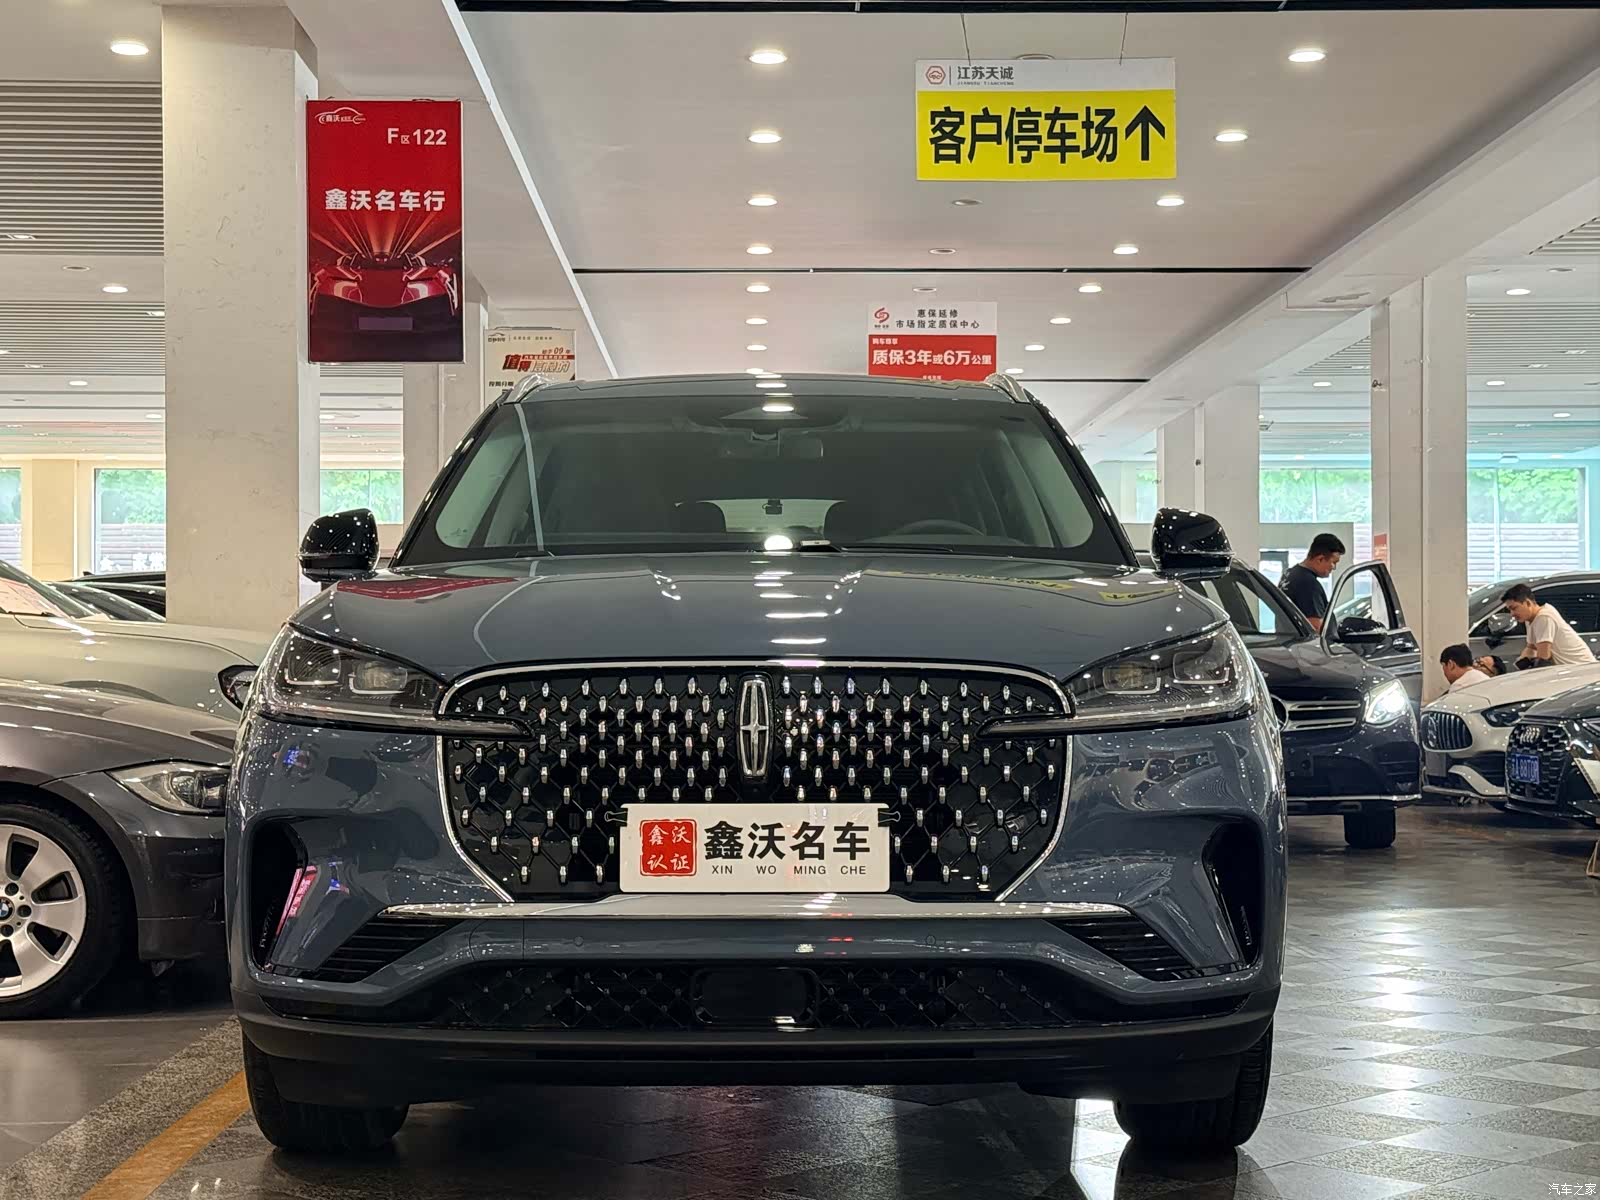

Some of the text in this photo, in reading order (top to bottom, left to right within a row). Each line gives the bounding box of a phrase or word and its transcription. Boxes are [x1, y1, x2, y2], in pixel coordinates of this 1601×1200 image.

[957, 66, 1014, 81] 江苏天诚
[929, 106, 1118, 164] 客户停车场
[325, 188, 446, 212] 鑫沃名车行
[917, 309, 958, 318] 惠保延修
[896, 319, 980, 329] 市场指定质保中心
[872, 349, 992, 365] 质保3年或6万公里
[647, 824, 692, 846] 鑫沃
[704, 821, 870, 861] 鑫沃名车
[647, 853, 691, 872] 认证
[711, 865, 867, 875] XIN WO MING CHE
